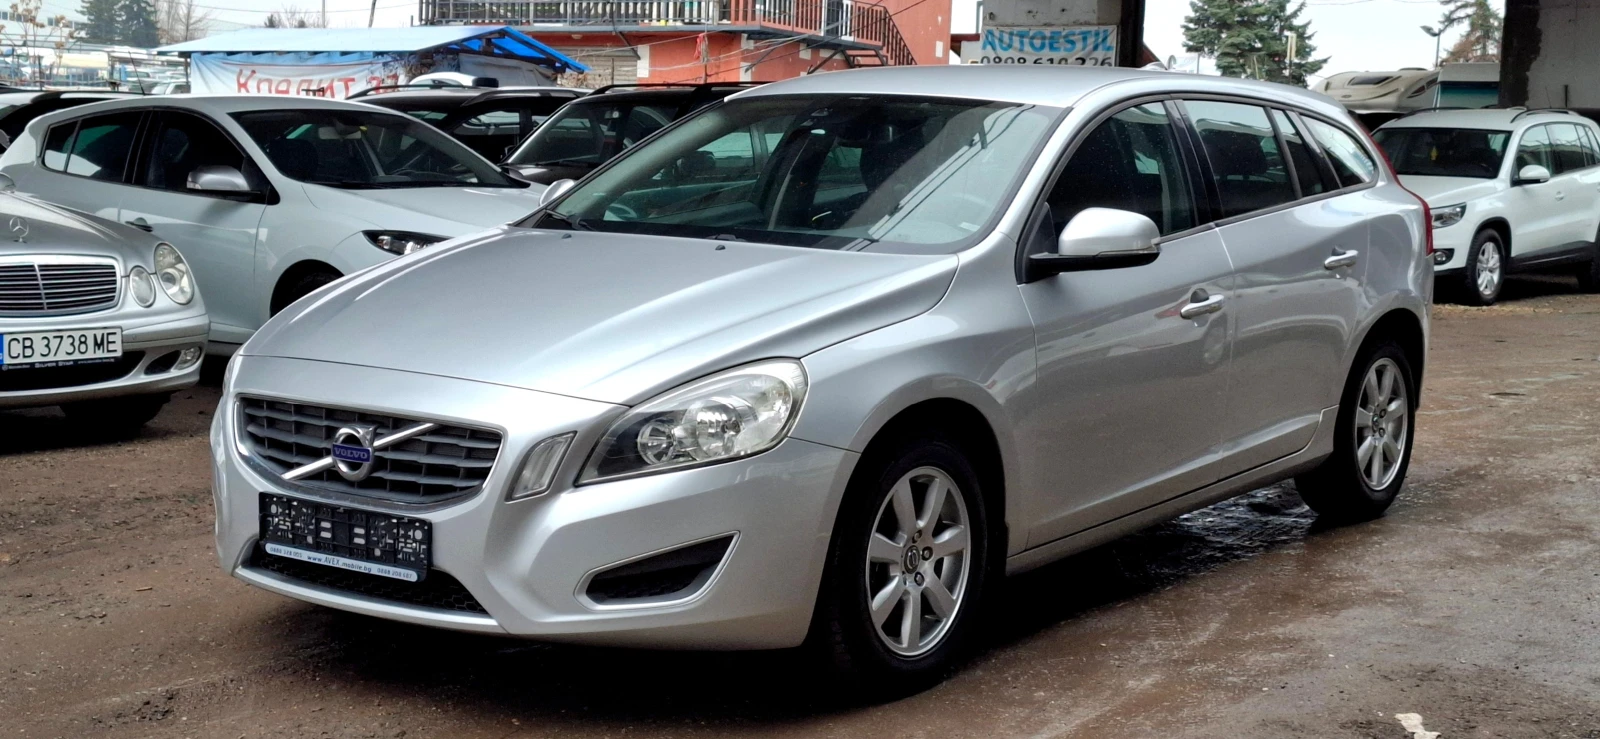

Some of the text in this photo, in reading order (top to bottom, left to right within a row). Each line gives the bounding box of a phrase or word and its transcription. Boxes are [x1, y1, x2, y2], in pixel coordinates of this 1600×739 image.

[982, 29, 1114, 52] AUTOESTIL
[8, 331, 118, 359] CB 3738 ME
[334, 447, 368, 459] VOLVO
